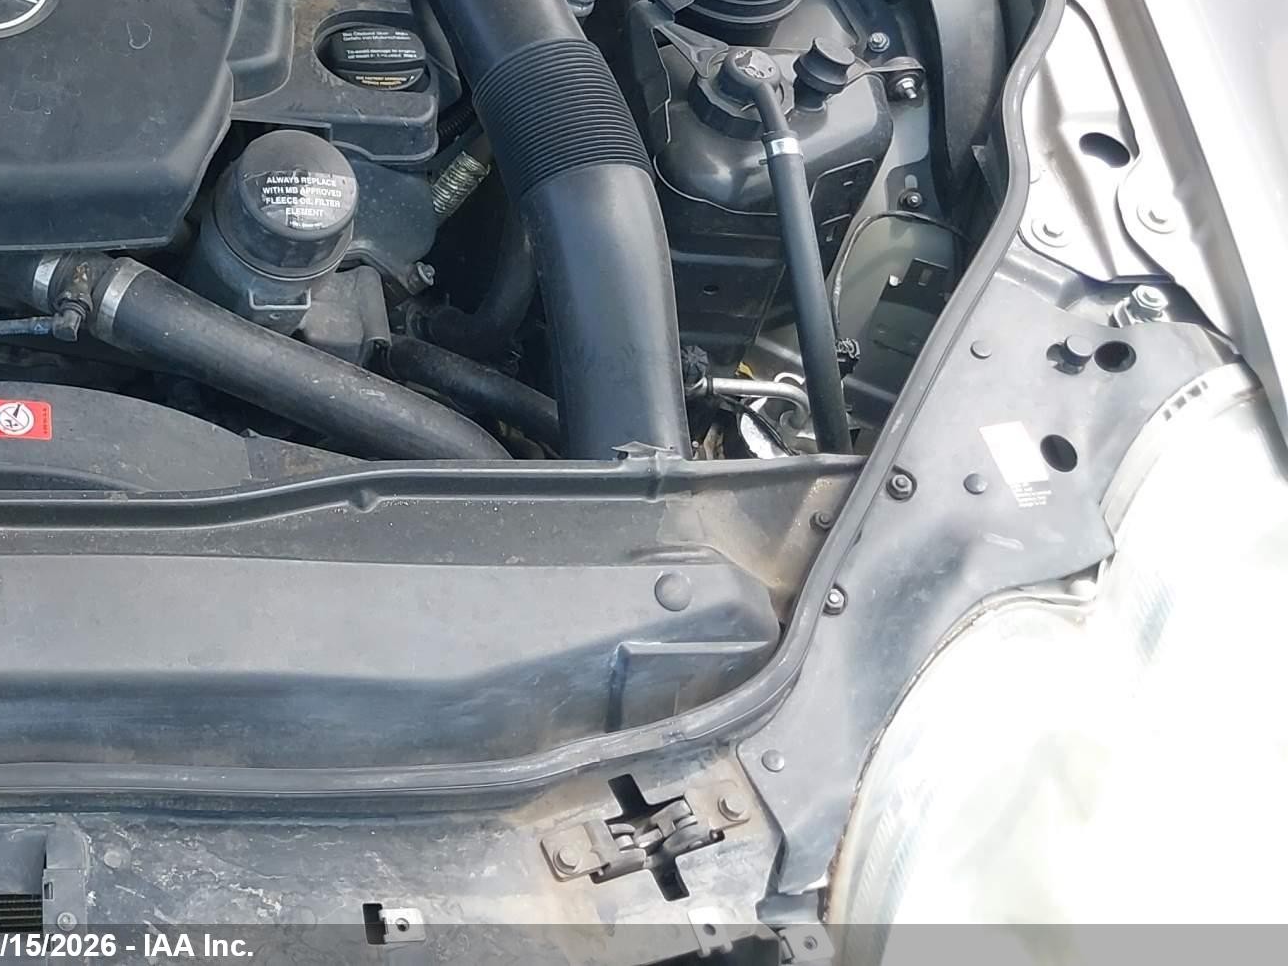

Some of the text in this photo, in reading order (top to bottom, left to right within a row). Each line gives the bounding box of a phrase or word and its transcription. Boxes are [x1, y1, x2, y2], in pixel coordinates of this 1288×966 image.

[266, 176, 337, 187] ALWAYS REPLACE
[262, 187, 285, 195] WITH
[300, 187, 342, 197] APPROVED
[265, 196, 341, 208] FLEECE OIL FILTER
[285, 207, 324, 217] ELEMENT
